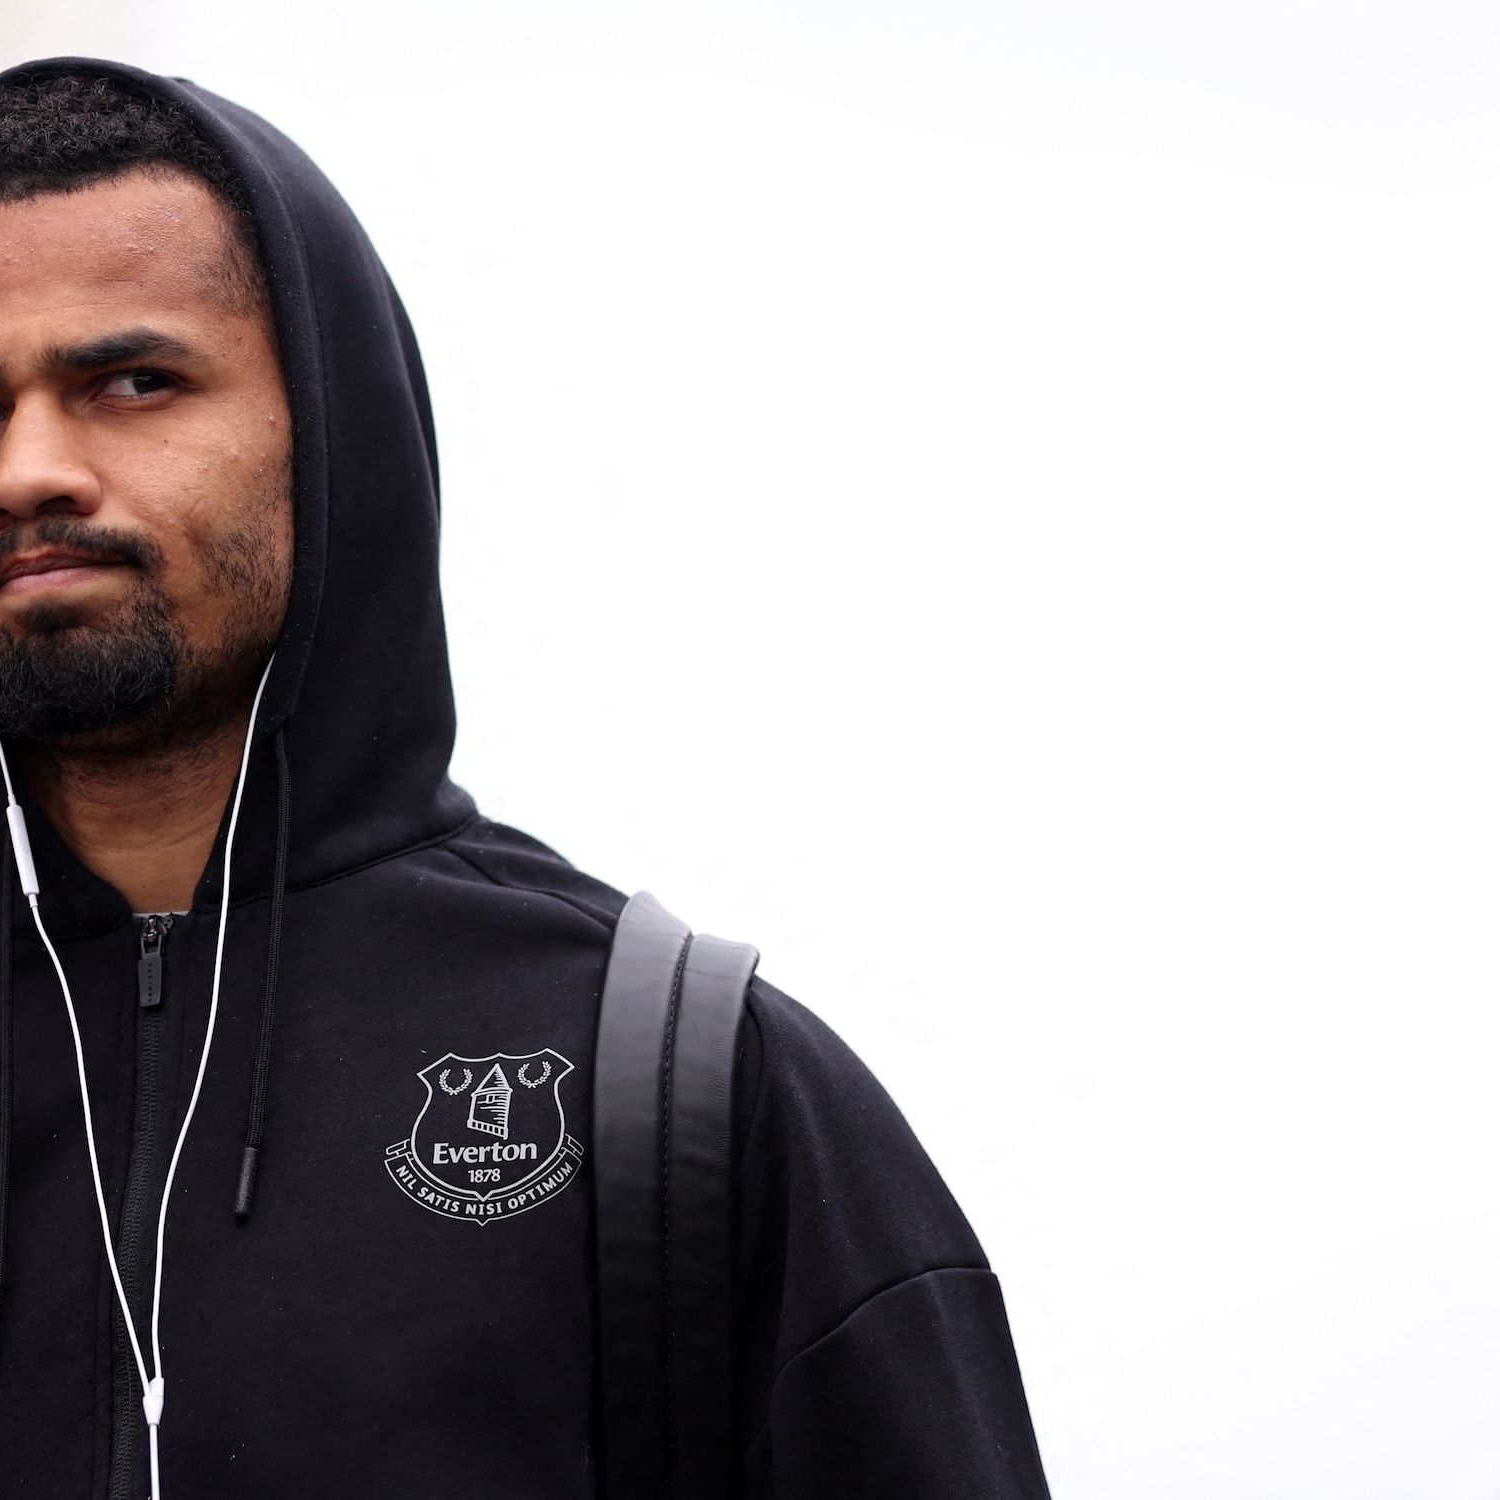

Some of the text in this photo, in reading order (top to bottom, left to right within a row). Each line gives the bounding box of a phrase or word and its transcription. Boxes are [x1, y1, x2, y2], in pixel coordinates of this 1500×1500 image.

[432, 1142, 538, 1165] Everton
[468, 1168, 501, 1183] 1878
[395, 1161, 574, 1216] NIL SATIS NISI OPTIMUM
